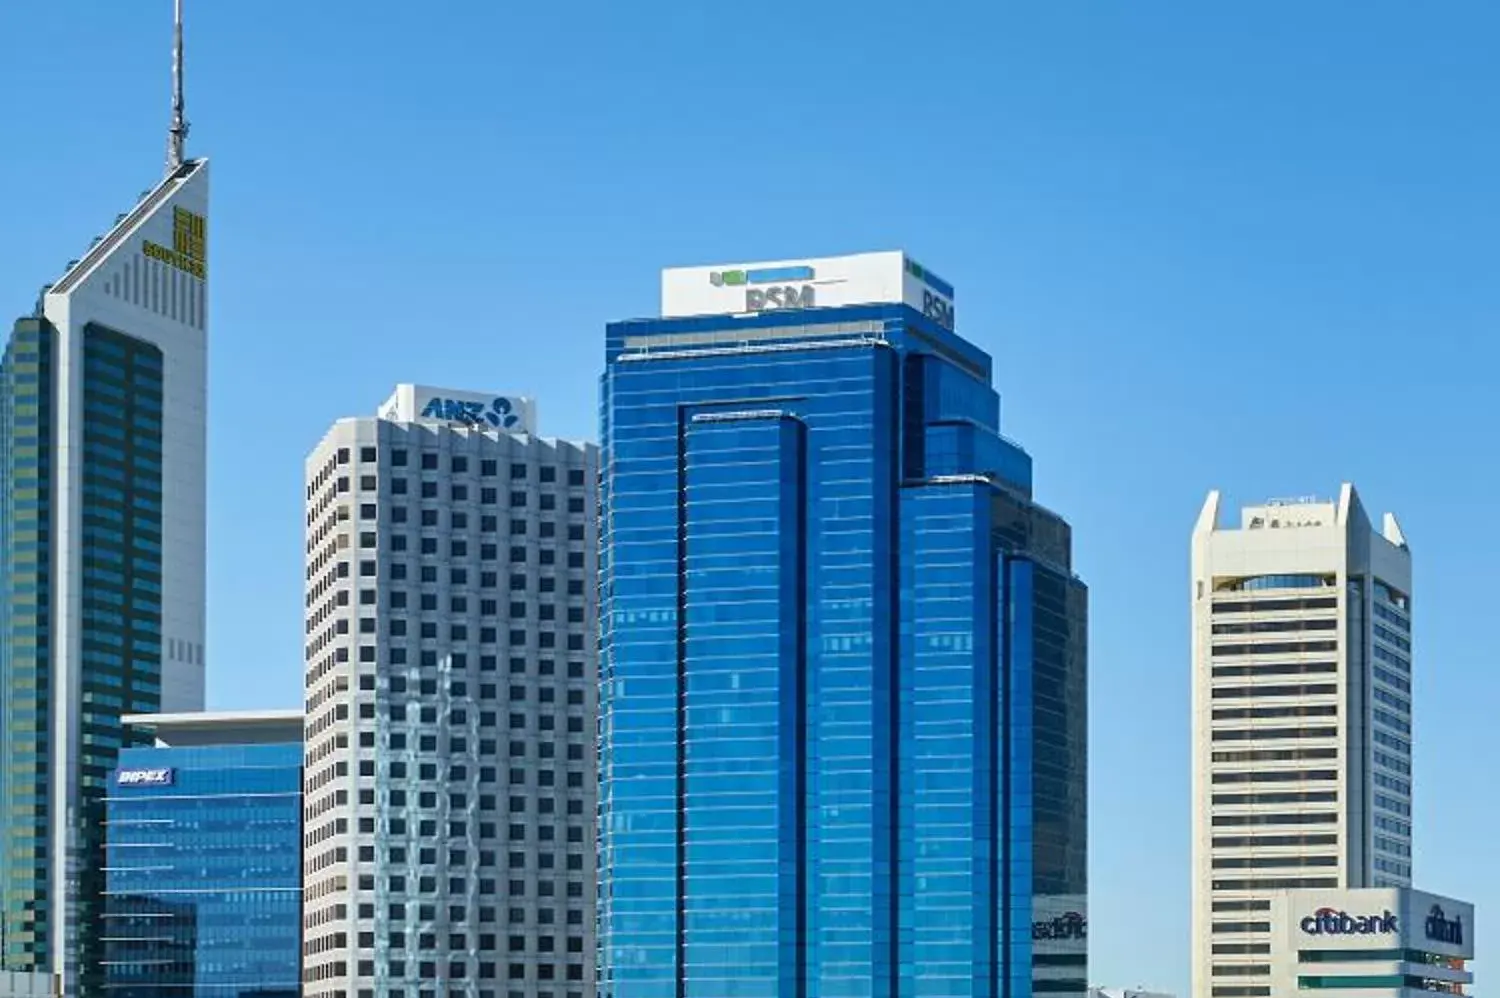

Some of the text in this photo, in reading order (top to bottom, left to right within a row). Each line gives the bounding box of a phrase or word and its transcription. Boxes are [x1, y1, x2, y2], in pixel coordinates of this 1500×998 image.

[746, 284, 815, 311] RSM
[923, 289, 954, 329] RSM
[421, 397, 485, 424] ANZ
[1301, 908, 1398, 935] citibank
